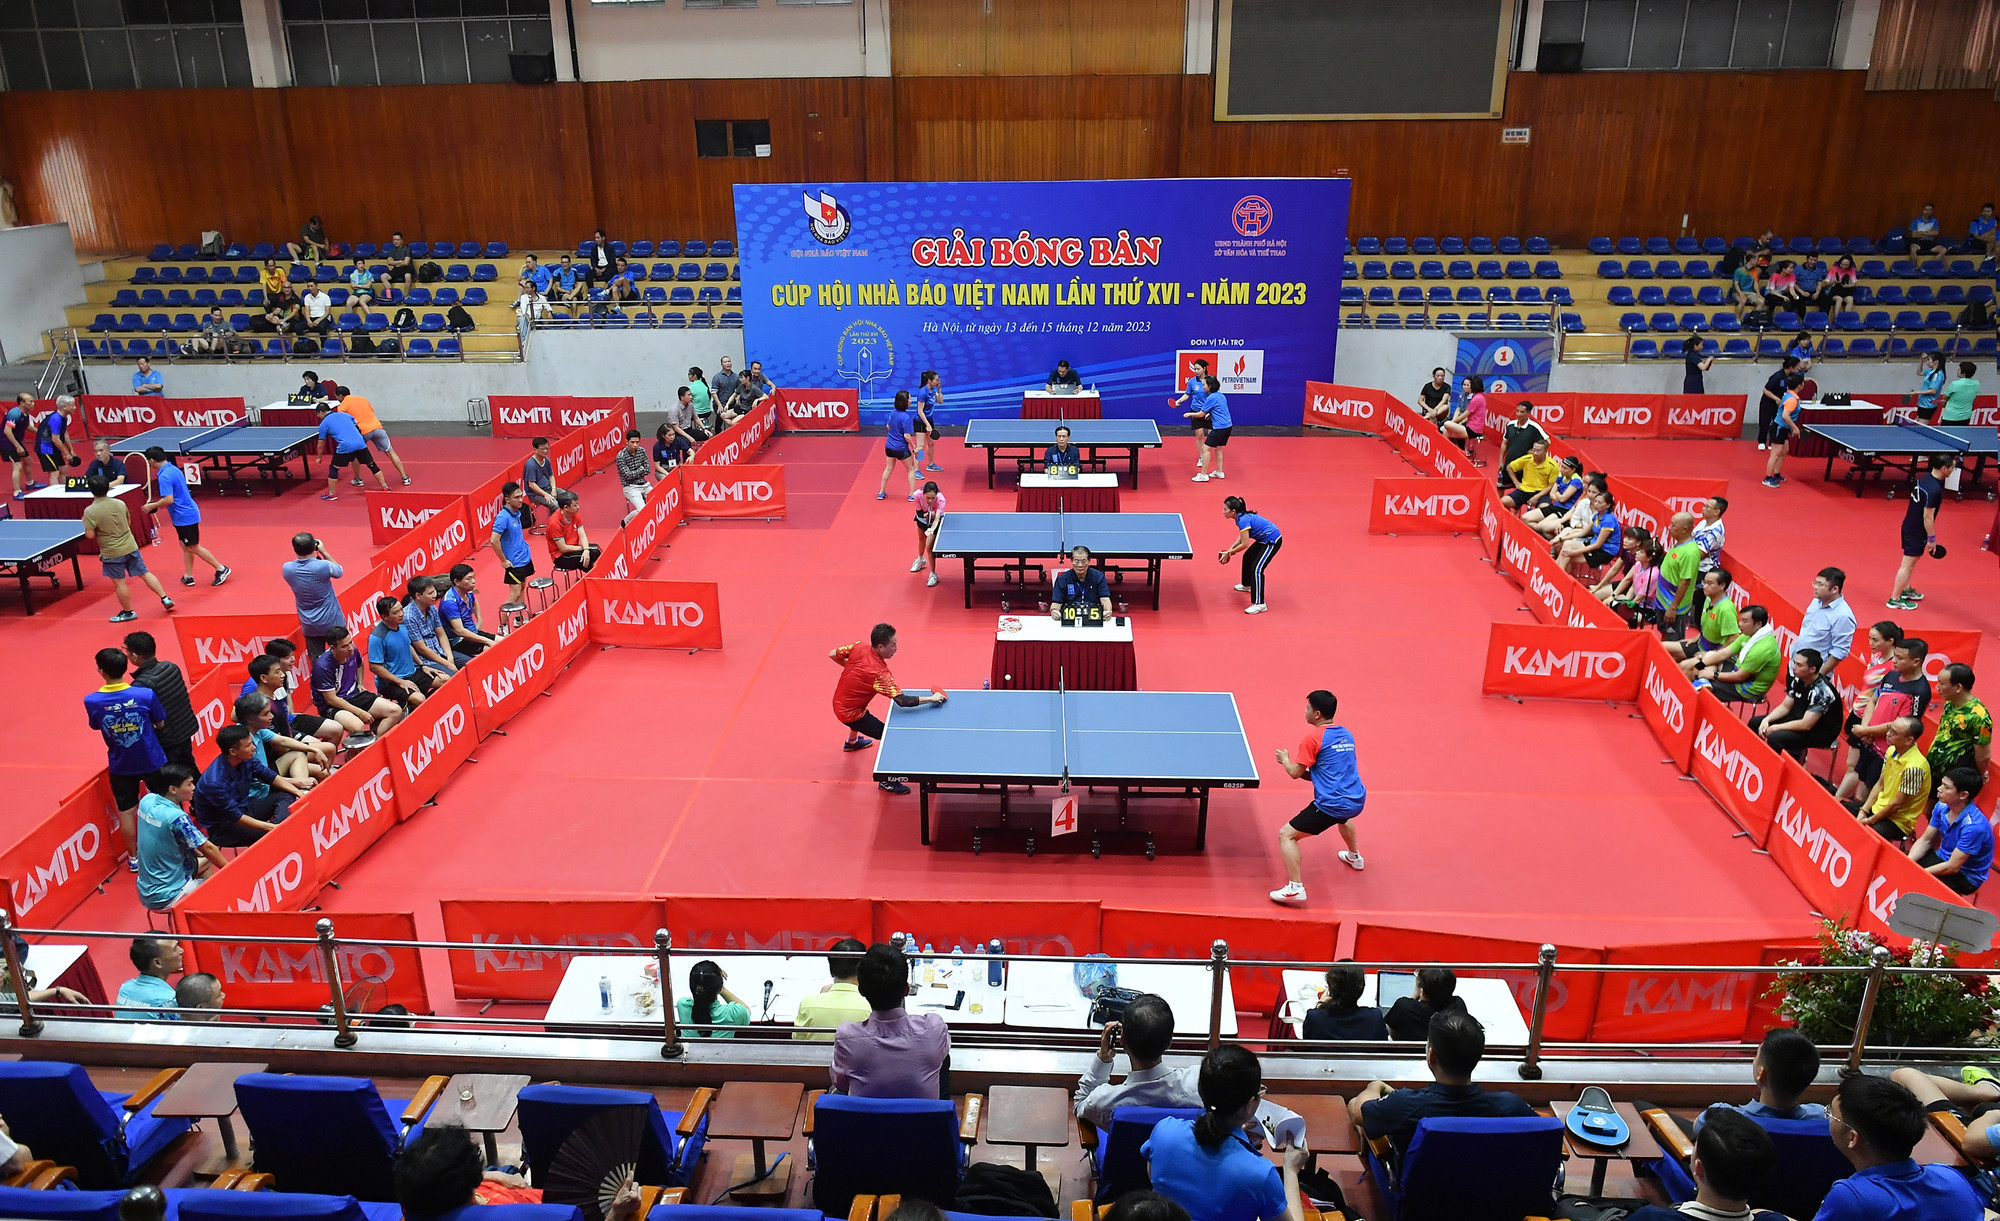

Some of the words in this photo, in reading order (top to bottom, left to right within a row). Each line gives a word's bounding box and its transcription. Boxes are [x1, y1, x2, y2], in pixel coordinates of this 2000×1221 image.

[912, 227, 986, 267] GIẢI
[990, 229, 1084, 267] BÓNG
[1088, 229, 1163, 267] BÀN
[771, 279, 812, 306] CÚP
[818, 279, 852, 311] HỘI
[858, 279, 900, 306] NHÀ
[906, 279, 947, 306] BÁO
[953, 279, 996, 311] VIỆT
[1002, 283, 1049, 306] NAM
[1056, 276, 1096, 306] LẦN
[1102, 276, 1144, 305] THỨ
[1146, 282, 1180, 305] XVI
[1201, 278, 1250, 305] NĂM
[1255, 282, 1307, 305] 2023
[923, 321, 938, 333] Hà
[941, 321, 963, 335] Nội,
[965, 322, 976, 333] từ
[978, 322, 1002, 335] ngày
[1005, 321, 1017, 333] 13
[1019, 321, 1038, 333] đến
[1041, 321, 1053, 333] 15
[1055, 321, 1084, 335] tháng
[1087, 321, 1099, 333] 12
[1102, 321, 1123, 333] năm
[1126, 321, 1151, 333] 2023
[1218, 338, 1229, 346] TÀI
[1231, 339, 1245, 347] TRỢ
[1500, 351, 1507, 361] 1
[1495, 384, 1503, 392] 2
[95, 407, 156, 423] KAMITO
[786, 401, 849, 418] KAMITO
[1313, 394, 1374, 419] KAMITO
[1583, 406, 1651, 424] KAMITO
[1668, 407, 1736, 425] KAMITO
[1385, 407, 1405, 436] KAMITO
[589, 426, 622, 458] KAMITO
[1405, 426, 1430, 456] KAMITO
[187, 465, 199, 483] 3
[1050, 466, 1058, 475] 8
[1069, 466, 1076, 475] 6
[68, 479, 76, 488] 9
[693, 481, 773, 501] KAMITO
[1385, 494, 1470, 516] KAMITO
[631, 519, 656, 562] KAMITO
[603, 598, 704, 627] KAMITO
[1064, 607, 1076, 620] 10
[1090, 607, 1100, 620] 5
[481, 642, 545, 708] KAMITO
[1503, 646, 1626, 679] KAMITO
[1645, 661, 1684, 734] KAMITO
[401, 703, 465, 783] KAMITO
[1693, 718, 1763, 802] KAMITO
[1055, 799, 1075, 831] 4
[1774, 789, 1852, 888] KAMITO
